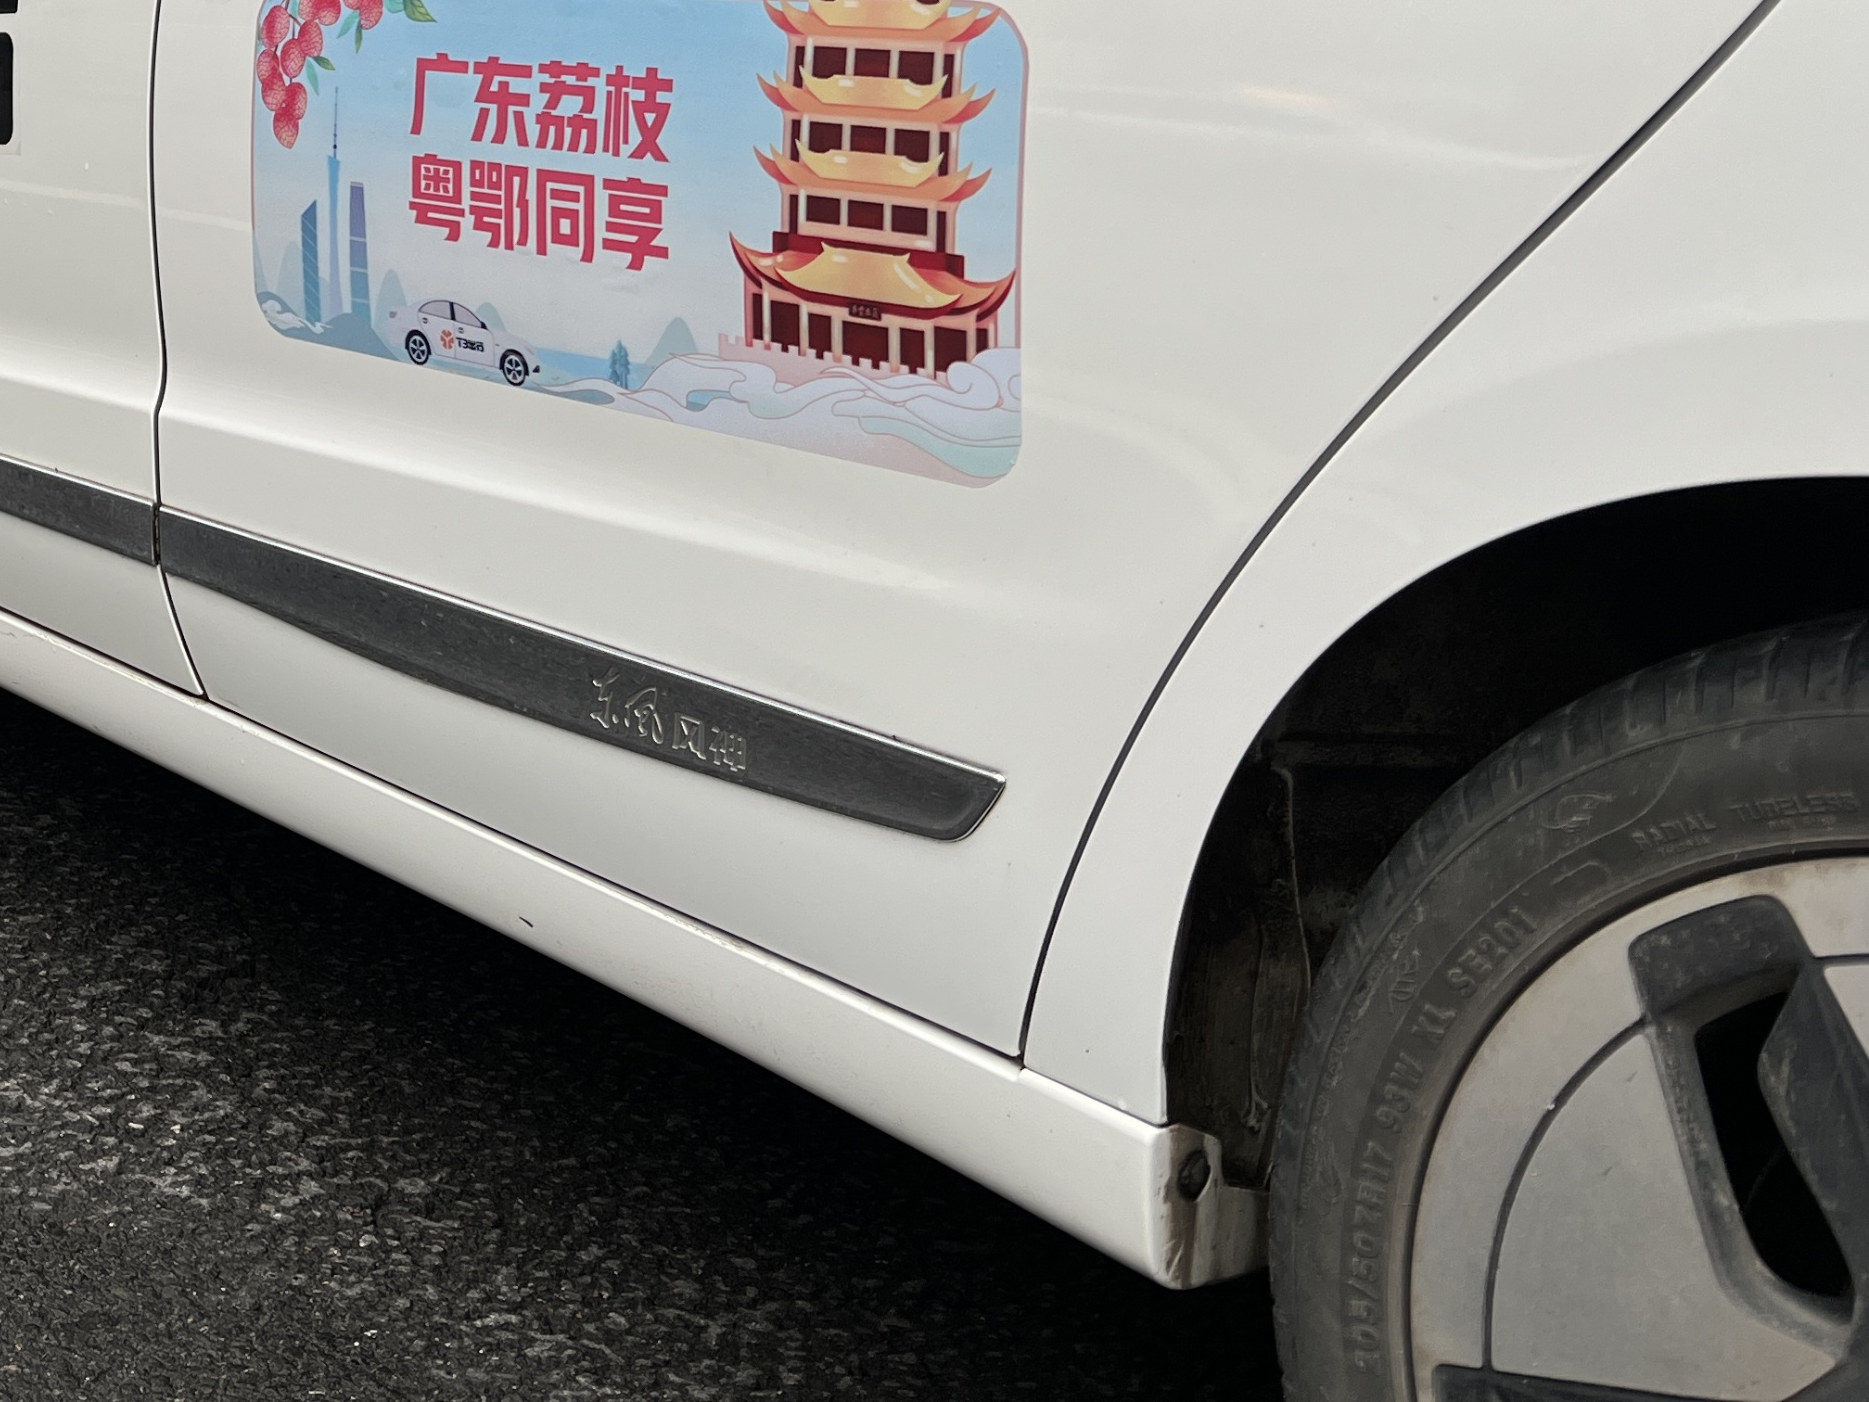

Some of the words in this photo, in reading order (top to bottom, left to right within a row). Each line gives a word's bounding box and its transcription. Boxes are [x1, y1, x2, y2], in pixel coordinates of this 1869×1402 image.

[410, 52, 674, 163] 广东荔枝
[408, 153, 670, 271] 粤鄂同享
